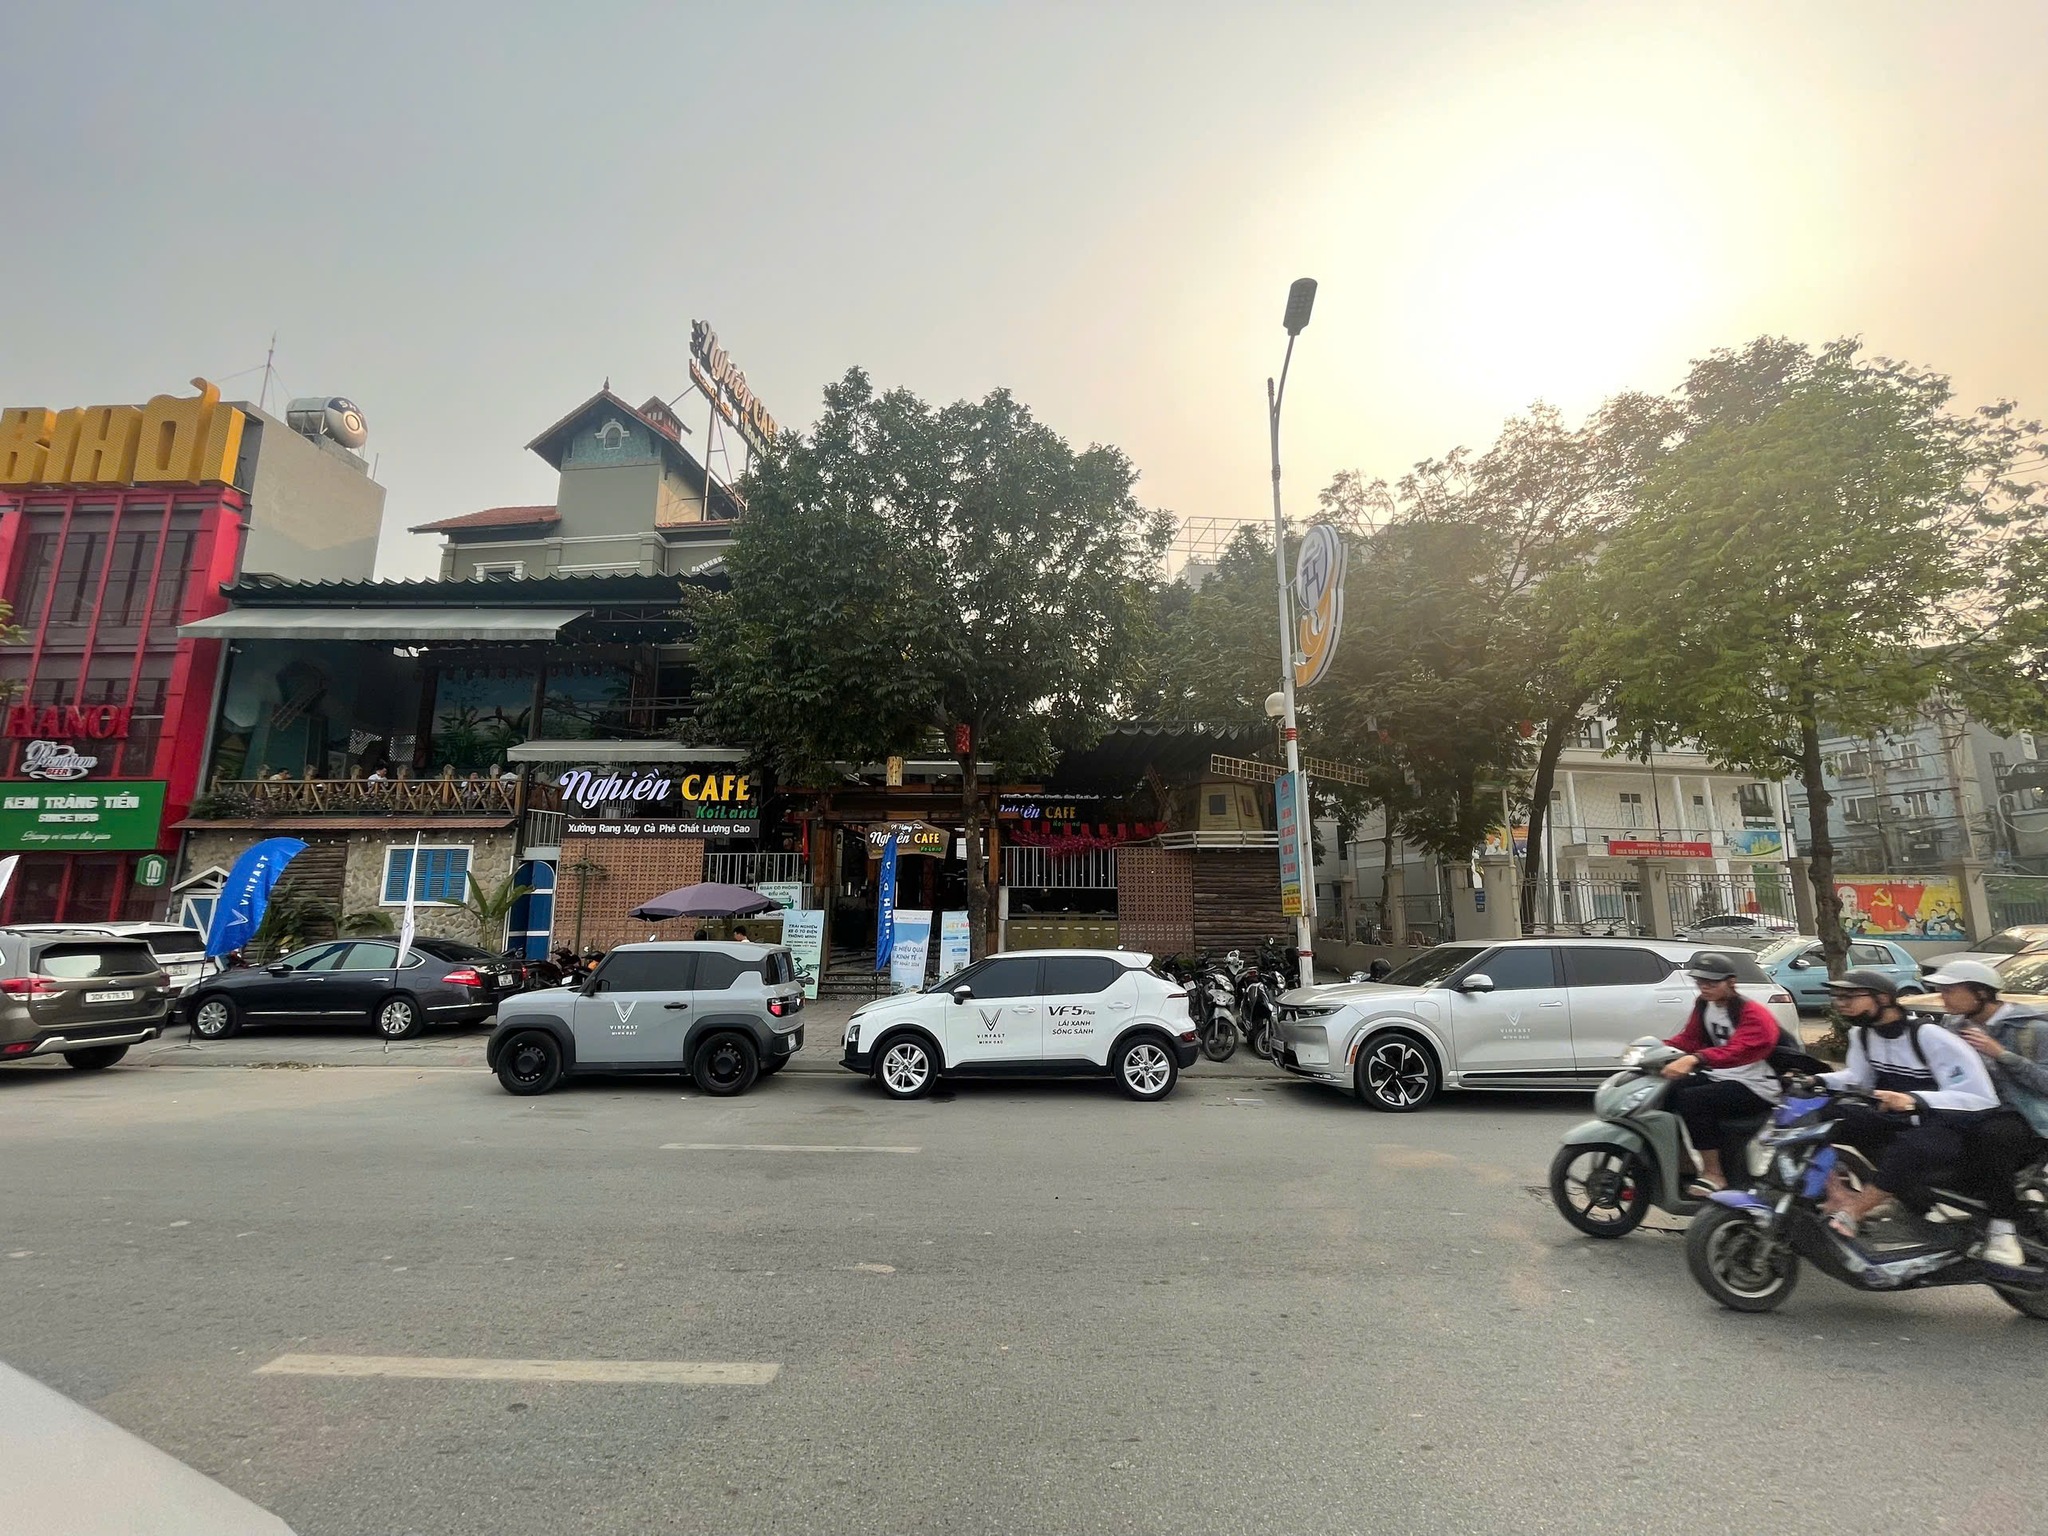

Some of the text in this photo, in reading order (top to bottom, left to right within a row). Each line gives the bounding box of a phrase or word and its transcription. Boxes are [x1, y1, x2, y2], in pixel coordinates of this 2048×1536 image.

[4, 704, 132, 738] HANOI
[45, 768, 70, 776] BEER
[559, 768, 750, 809] Nghiền CAFE
[1045, 806, 1076, 819] CAFE
[599, 824, 621, 835] Rang
[624, 824, 641, 835] Xay
[659, 823, 676, 833] Phê
[678, 822, 700, 833] Chất
[702, 824, 730, 836] Lượng
[733, 824, 750, 833] Cao
[914, 833, 940, 844] CAFE
[240, 854, 269, 906] VINFAST
